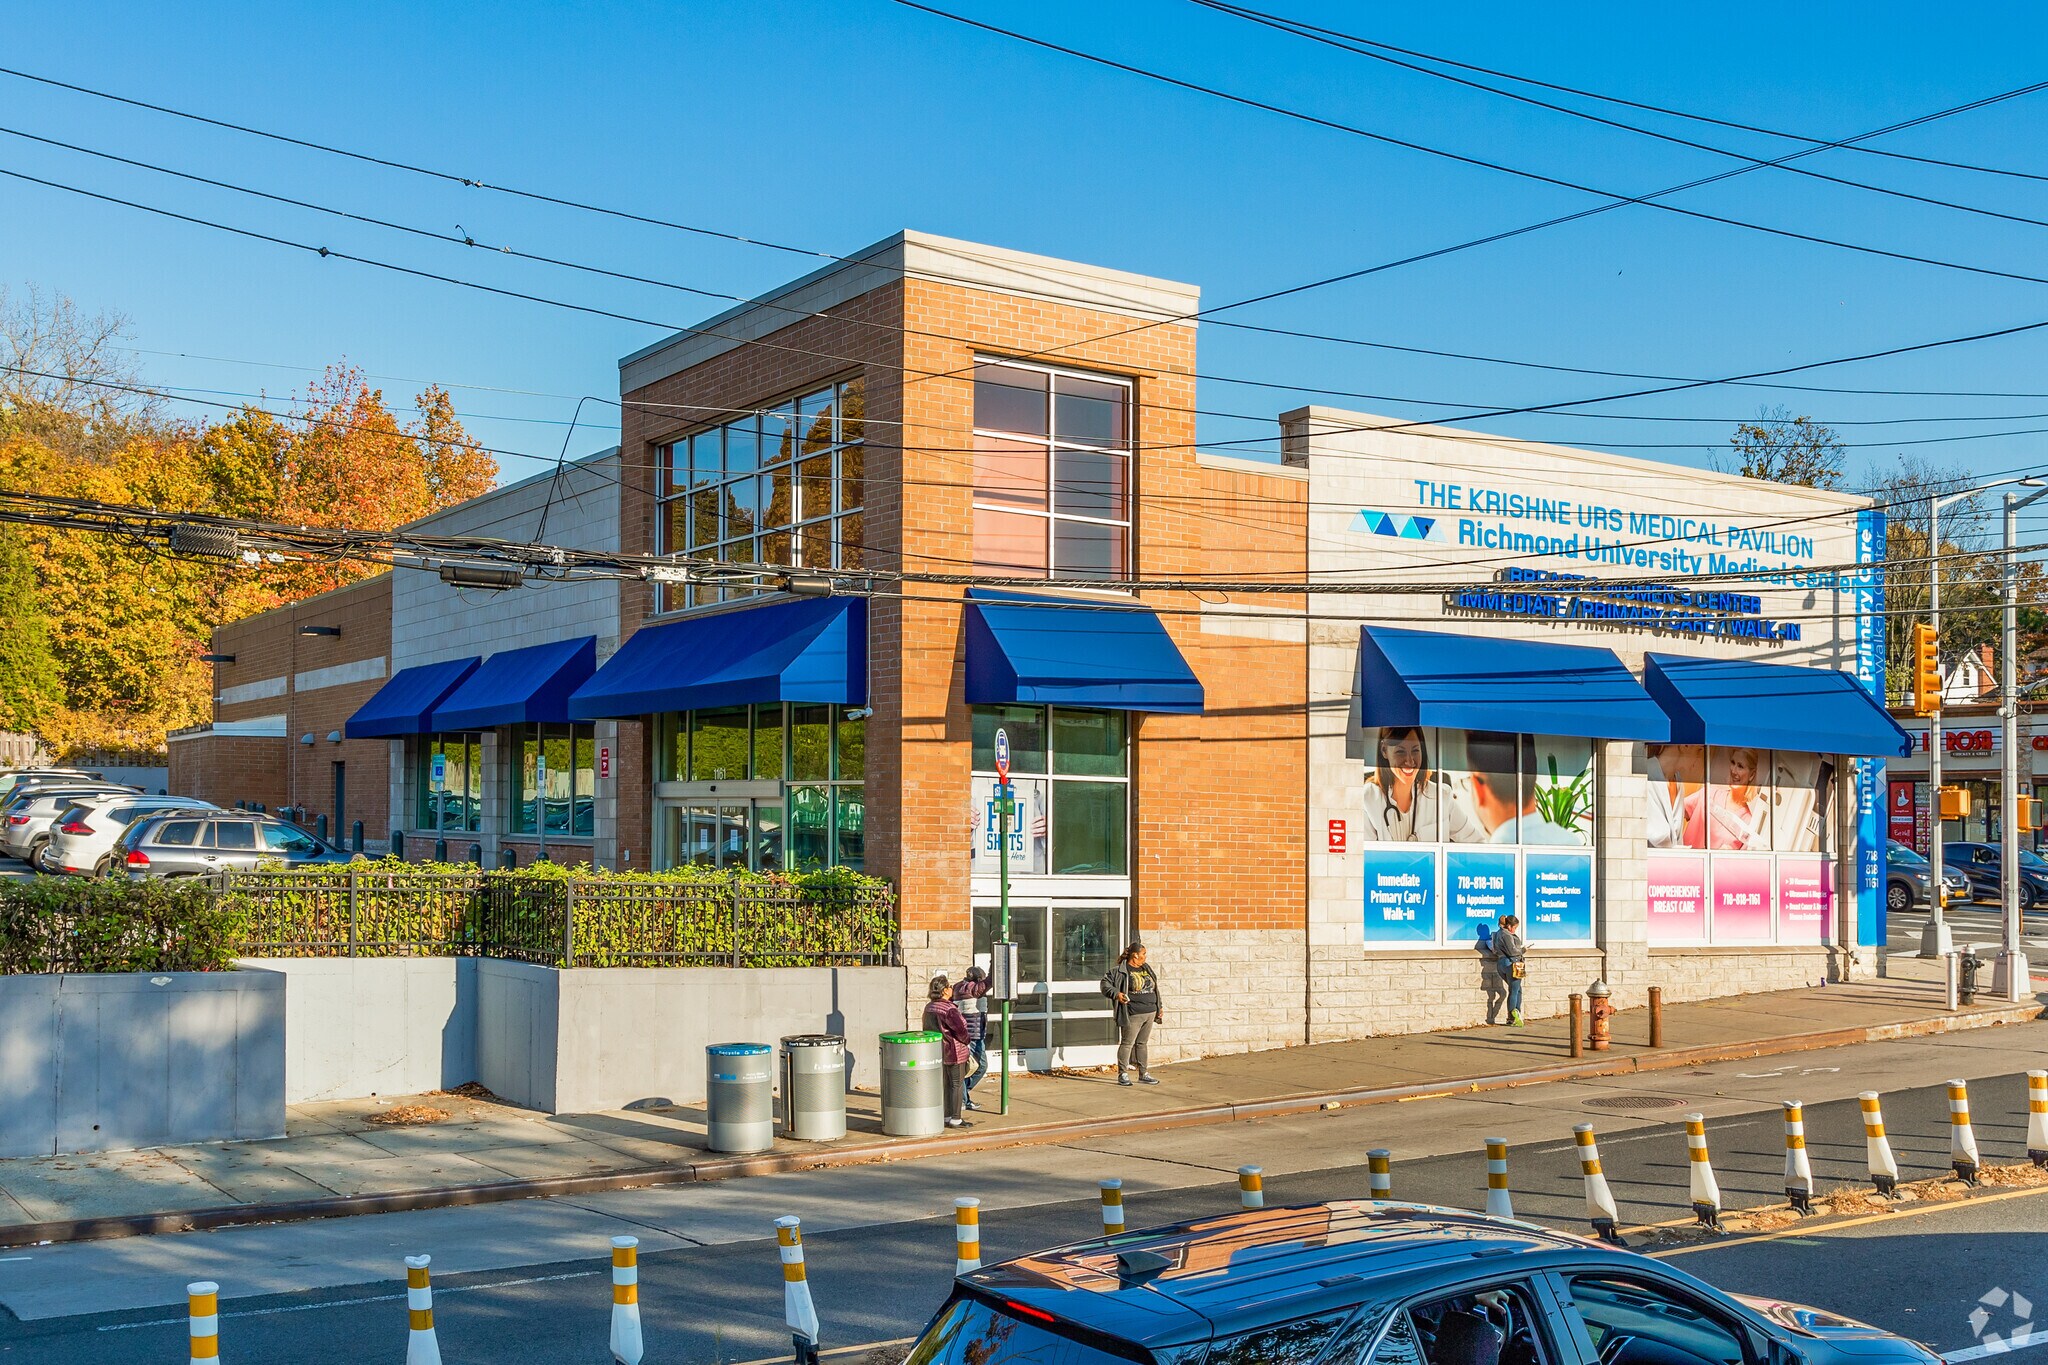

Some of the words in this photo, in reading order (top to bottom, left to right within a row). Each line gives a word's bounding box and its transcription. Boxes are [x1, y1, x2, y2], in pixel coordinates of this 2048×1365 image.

[1414, 479, 1462, 510] THE
[1468, 487, 1571, 526] KRISHNE
[1577, 503, 1624, 533] URS
[1629, 511, 1723, 547] MEDICAL
[1727, 525, 1814, 560] PAVILION
[1458, 518, 1579, 559] Richmond
[1584, 535, 1702, 576] University
[1708, 552, 1787, 586] Medical
[1793, 564, 1859, 595] Center
[1857, 528, 1873, 583] Care
[1874, 531, 1885, 595] Center
[1696, 591, 1762, 615] CENTER
[1459, 588, 1568, 618] IMMEDIATE
[1582, 601, 1666, 627] PRIMARY
[1669, 610, 1717, 635] CARE
[1731, 619, 1801, 641] WALK-IN
[1858, 589, 1874, 682] Primary
[1875, 602, 1885, 674] Walk-in
[986, 801, 1025, 833] FU
[986, 833, 1023, 851] SHTS
[1010, 850, 1026, 861] Here
[1865, 850, 1878, 861] 718
[1558, 872, 1568, 881] Care
[1865, 864, 1878, 875] 818
[1377, 873, 1421, 887] Immediate
[1457, 876, 1504, 890] 718-818-1161
[1865, 877, 1879, 888] 1161
[1370, 889, 1402, 906] Primary
[1403, 889, 1421, 904] Care
[1541, 886, 1564, 896] Diagnostic
[1563, 886, 1582, 895] Services
[1648, 885, 1701, 898] COMPREHENSIVE
[1456, 894, 1466, 905] No
[1466, 894, 1505, 906] Appointment
[1653, 900, 1678, 913] BREAST
[1678, 900, 1696, 913] CARE
[1722, 893, 1761, 906] 718-818-1161
[1382, 906, 1415, 921] Walk-in
[1466, 906, 1496, 920] Necessary
